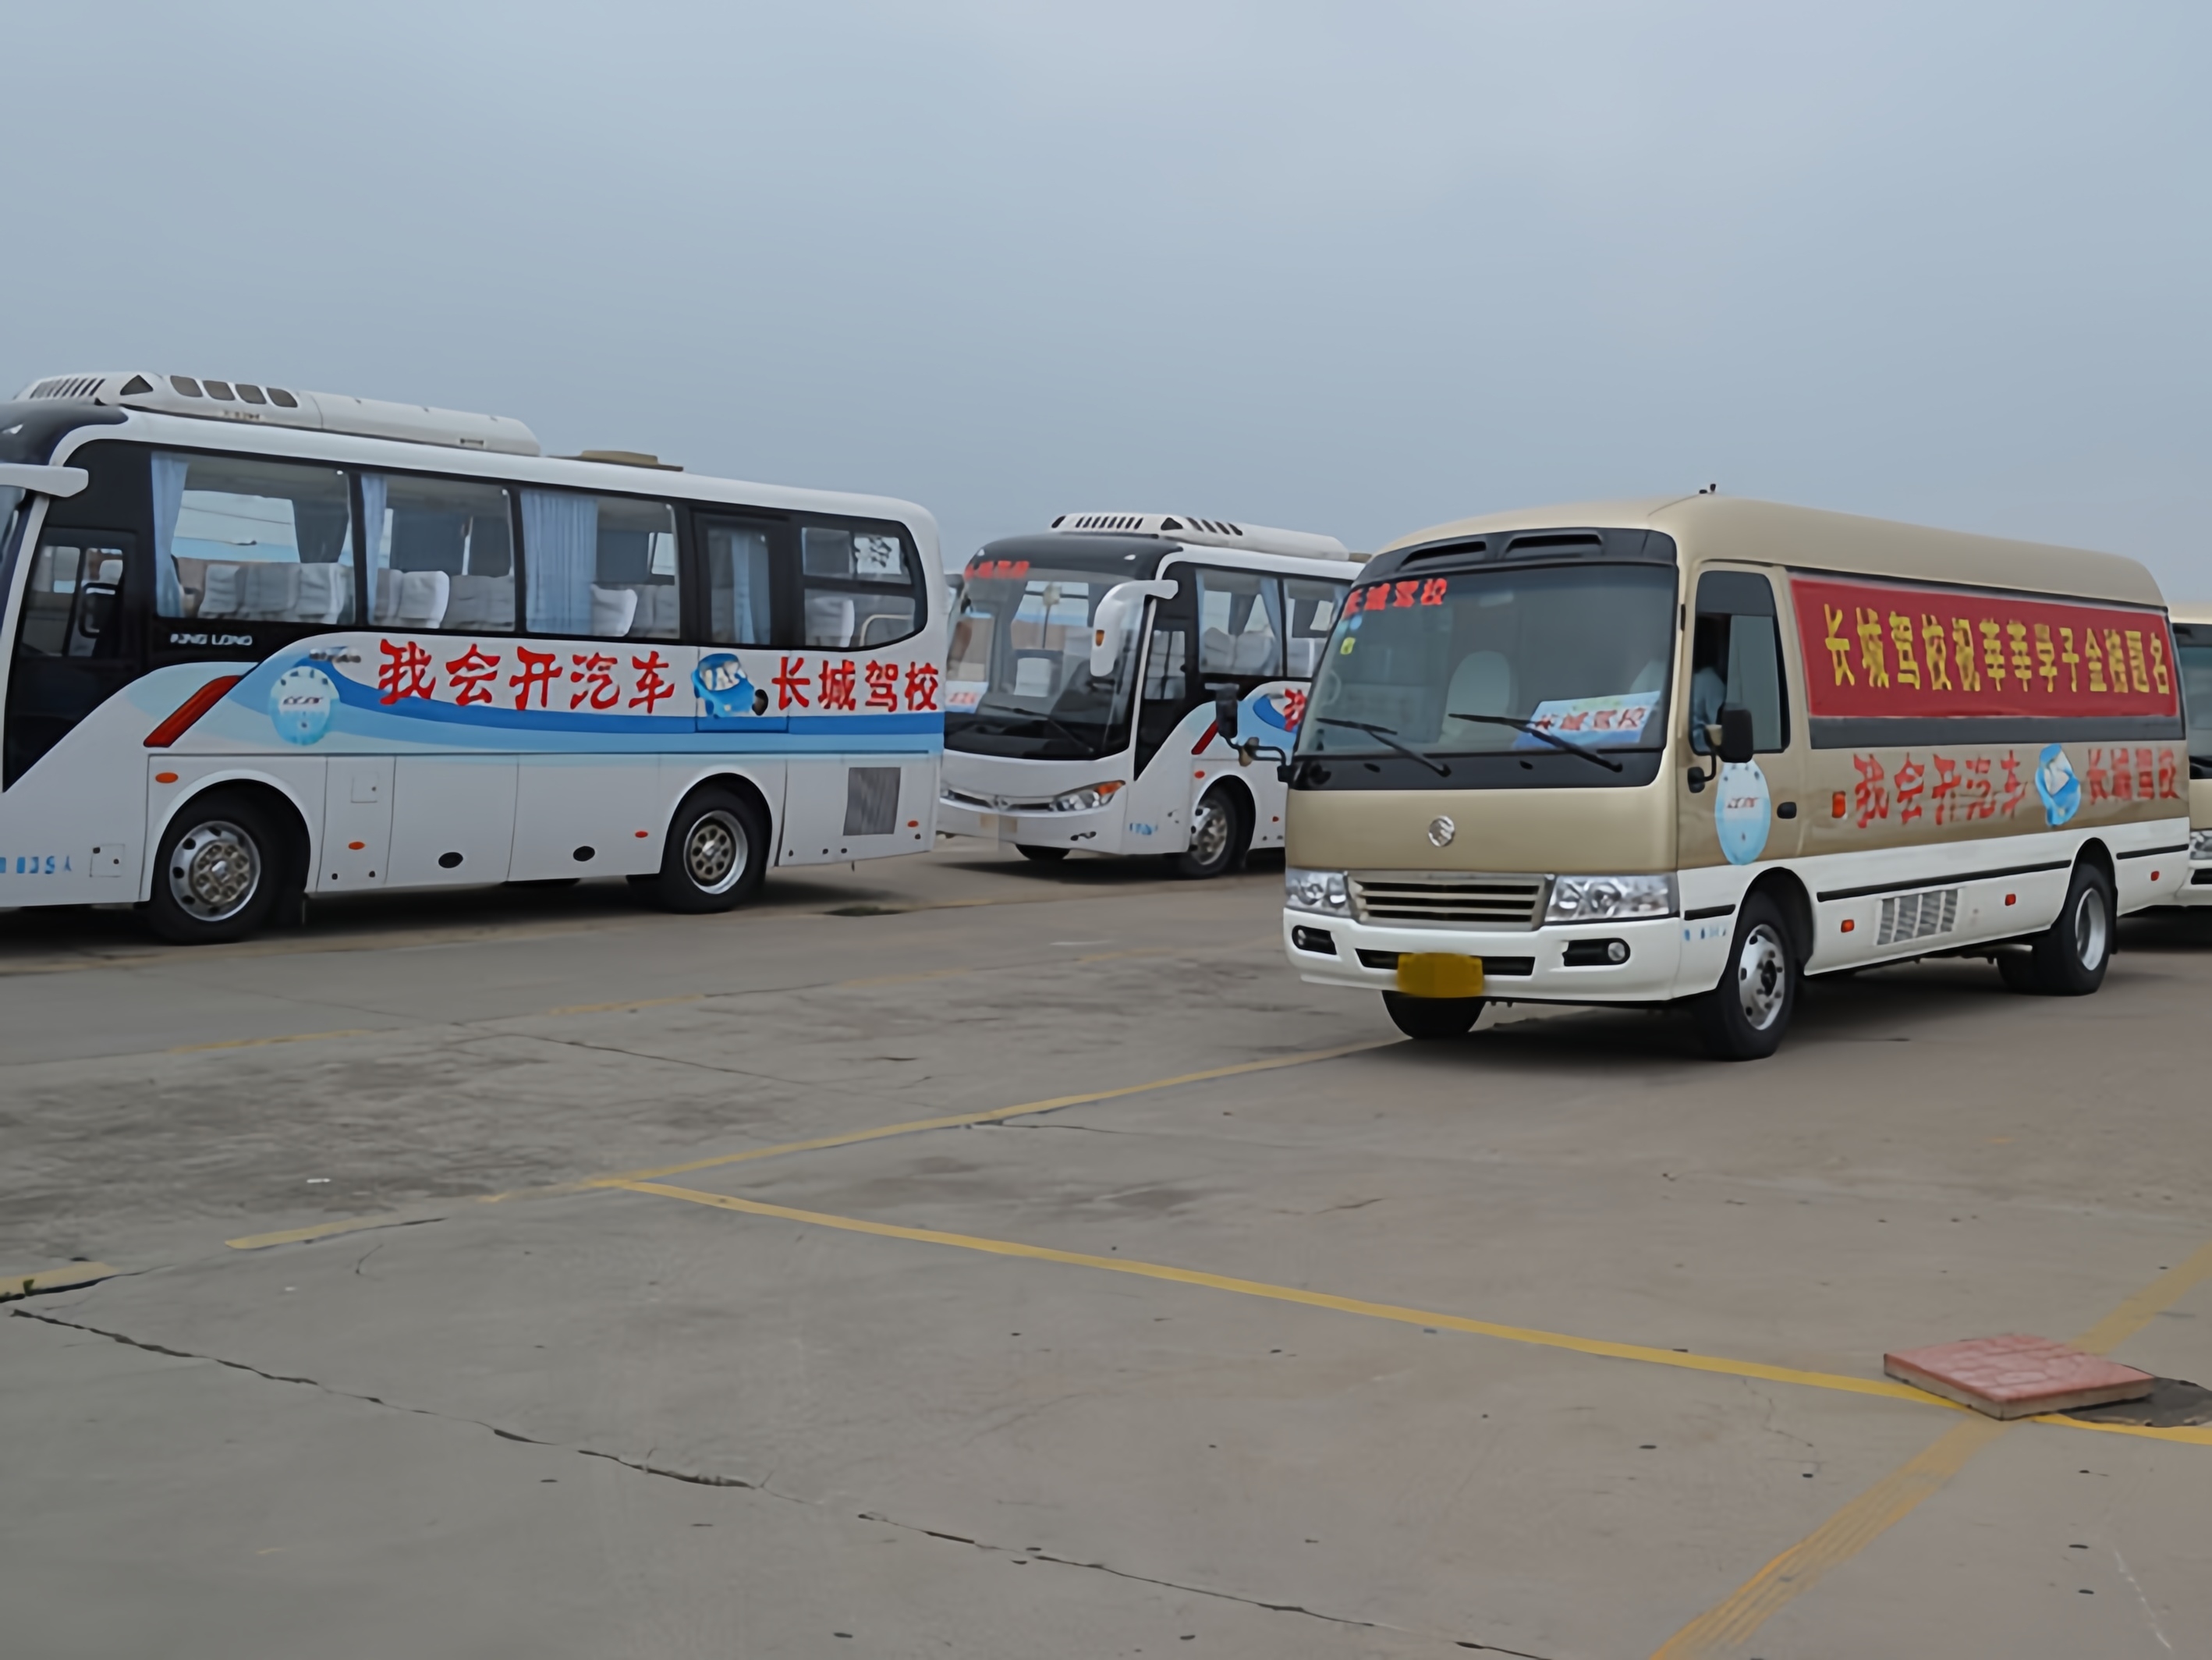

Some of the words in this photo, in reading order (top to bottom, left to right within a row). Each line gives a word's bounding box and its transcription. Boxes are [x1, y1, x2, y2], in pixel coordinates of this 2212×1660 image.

[378, 638, 675, 714] 我会开汽车
[771, 656, 938, 712] 长城驾校
[1853, 750, 2029, 828] 我会开汽车
